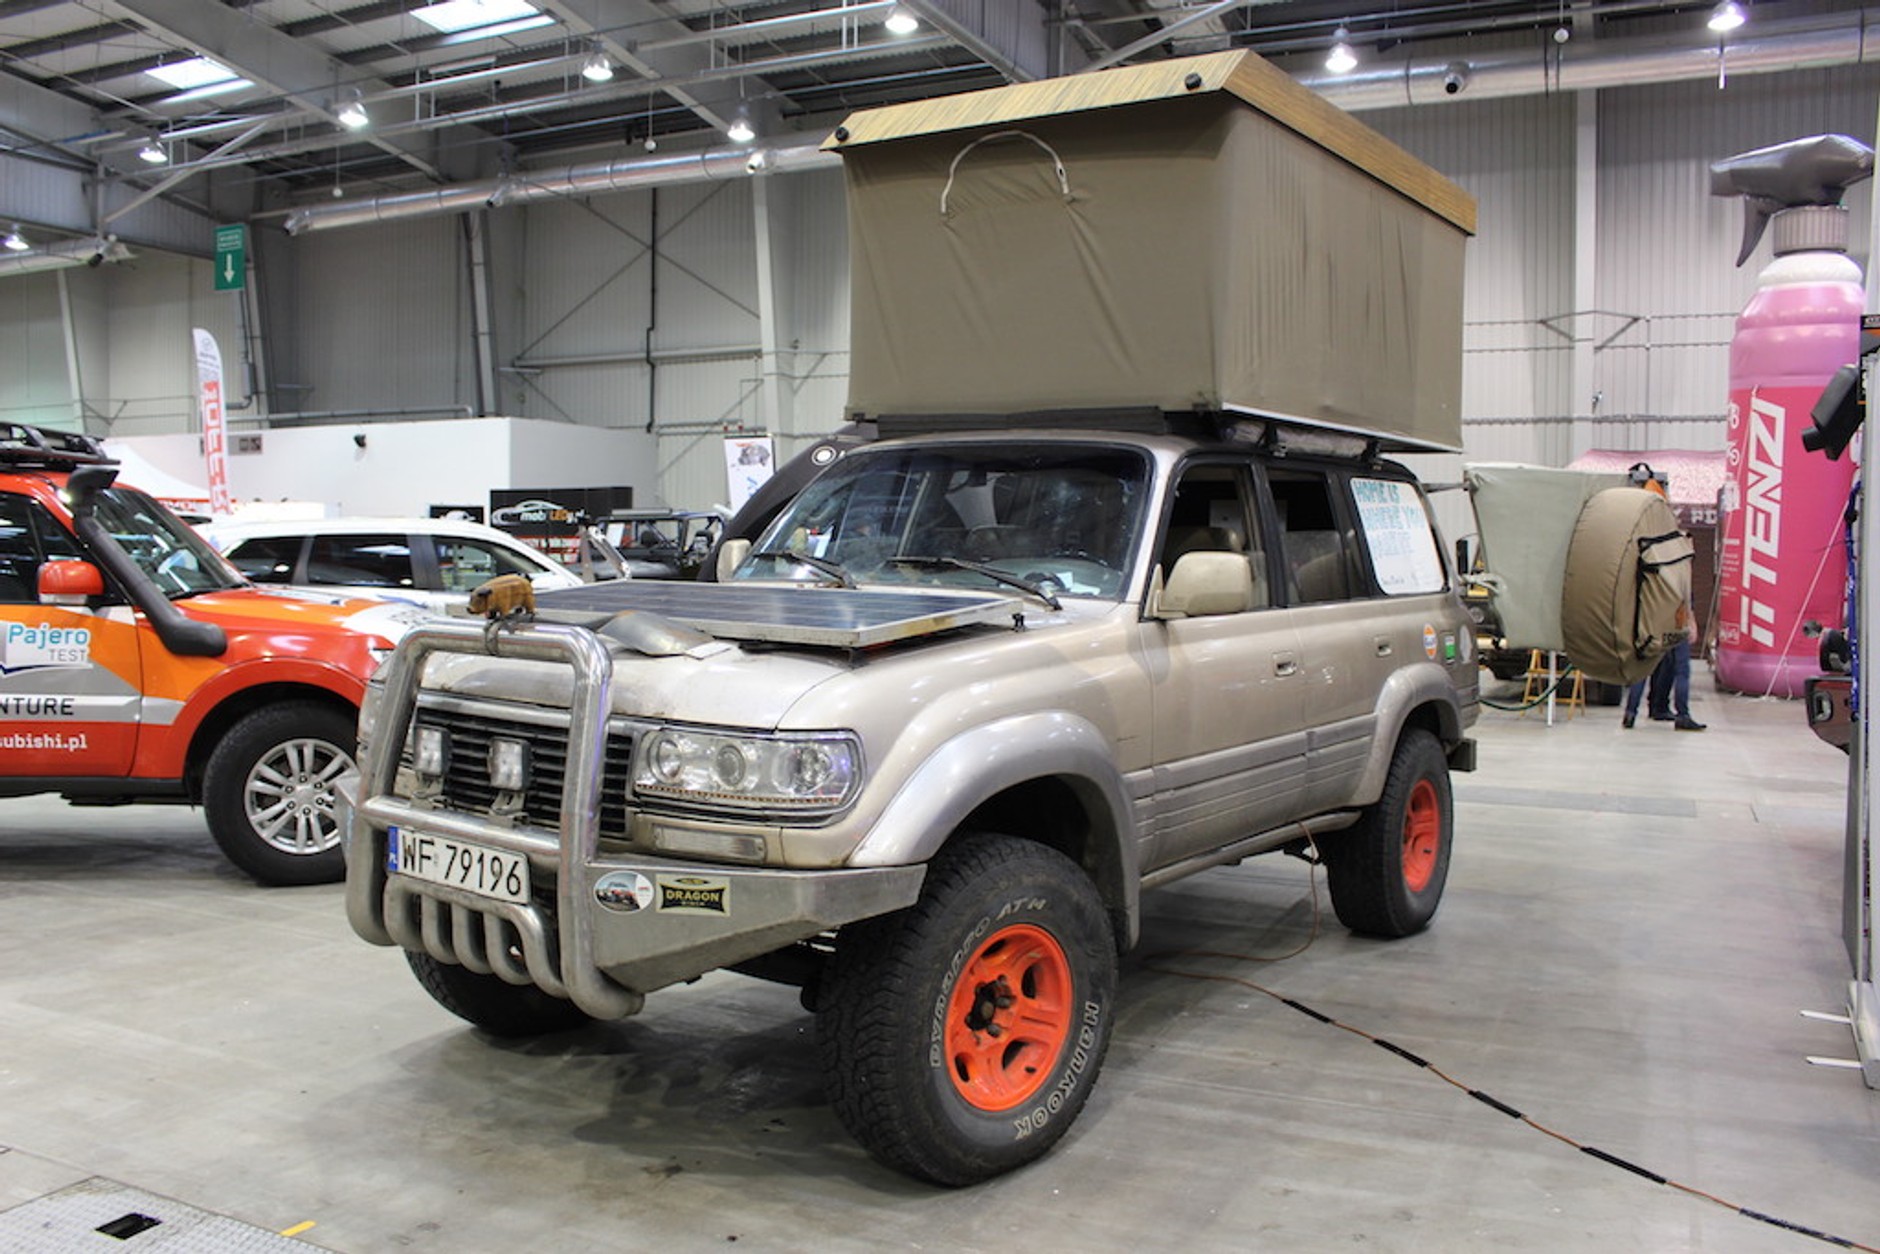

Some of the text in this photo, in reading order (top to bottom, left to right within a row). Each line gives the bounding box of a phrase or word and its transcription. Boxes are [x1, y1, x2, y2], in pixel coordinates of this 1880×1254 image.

[1743, 396, 1786, 590] TENZI
[8, 624, 89, 650] Pajero
[48, 648, 88, 662] TEST
[0, 697, 75, 716] NTURE
[401, 834, 521, 896] WF 79196
[665, 889, 720, 902] DRAGON
